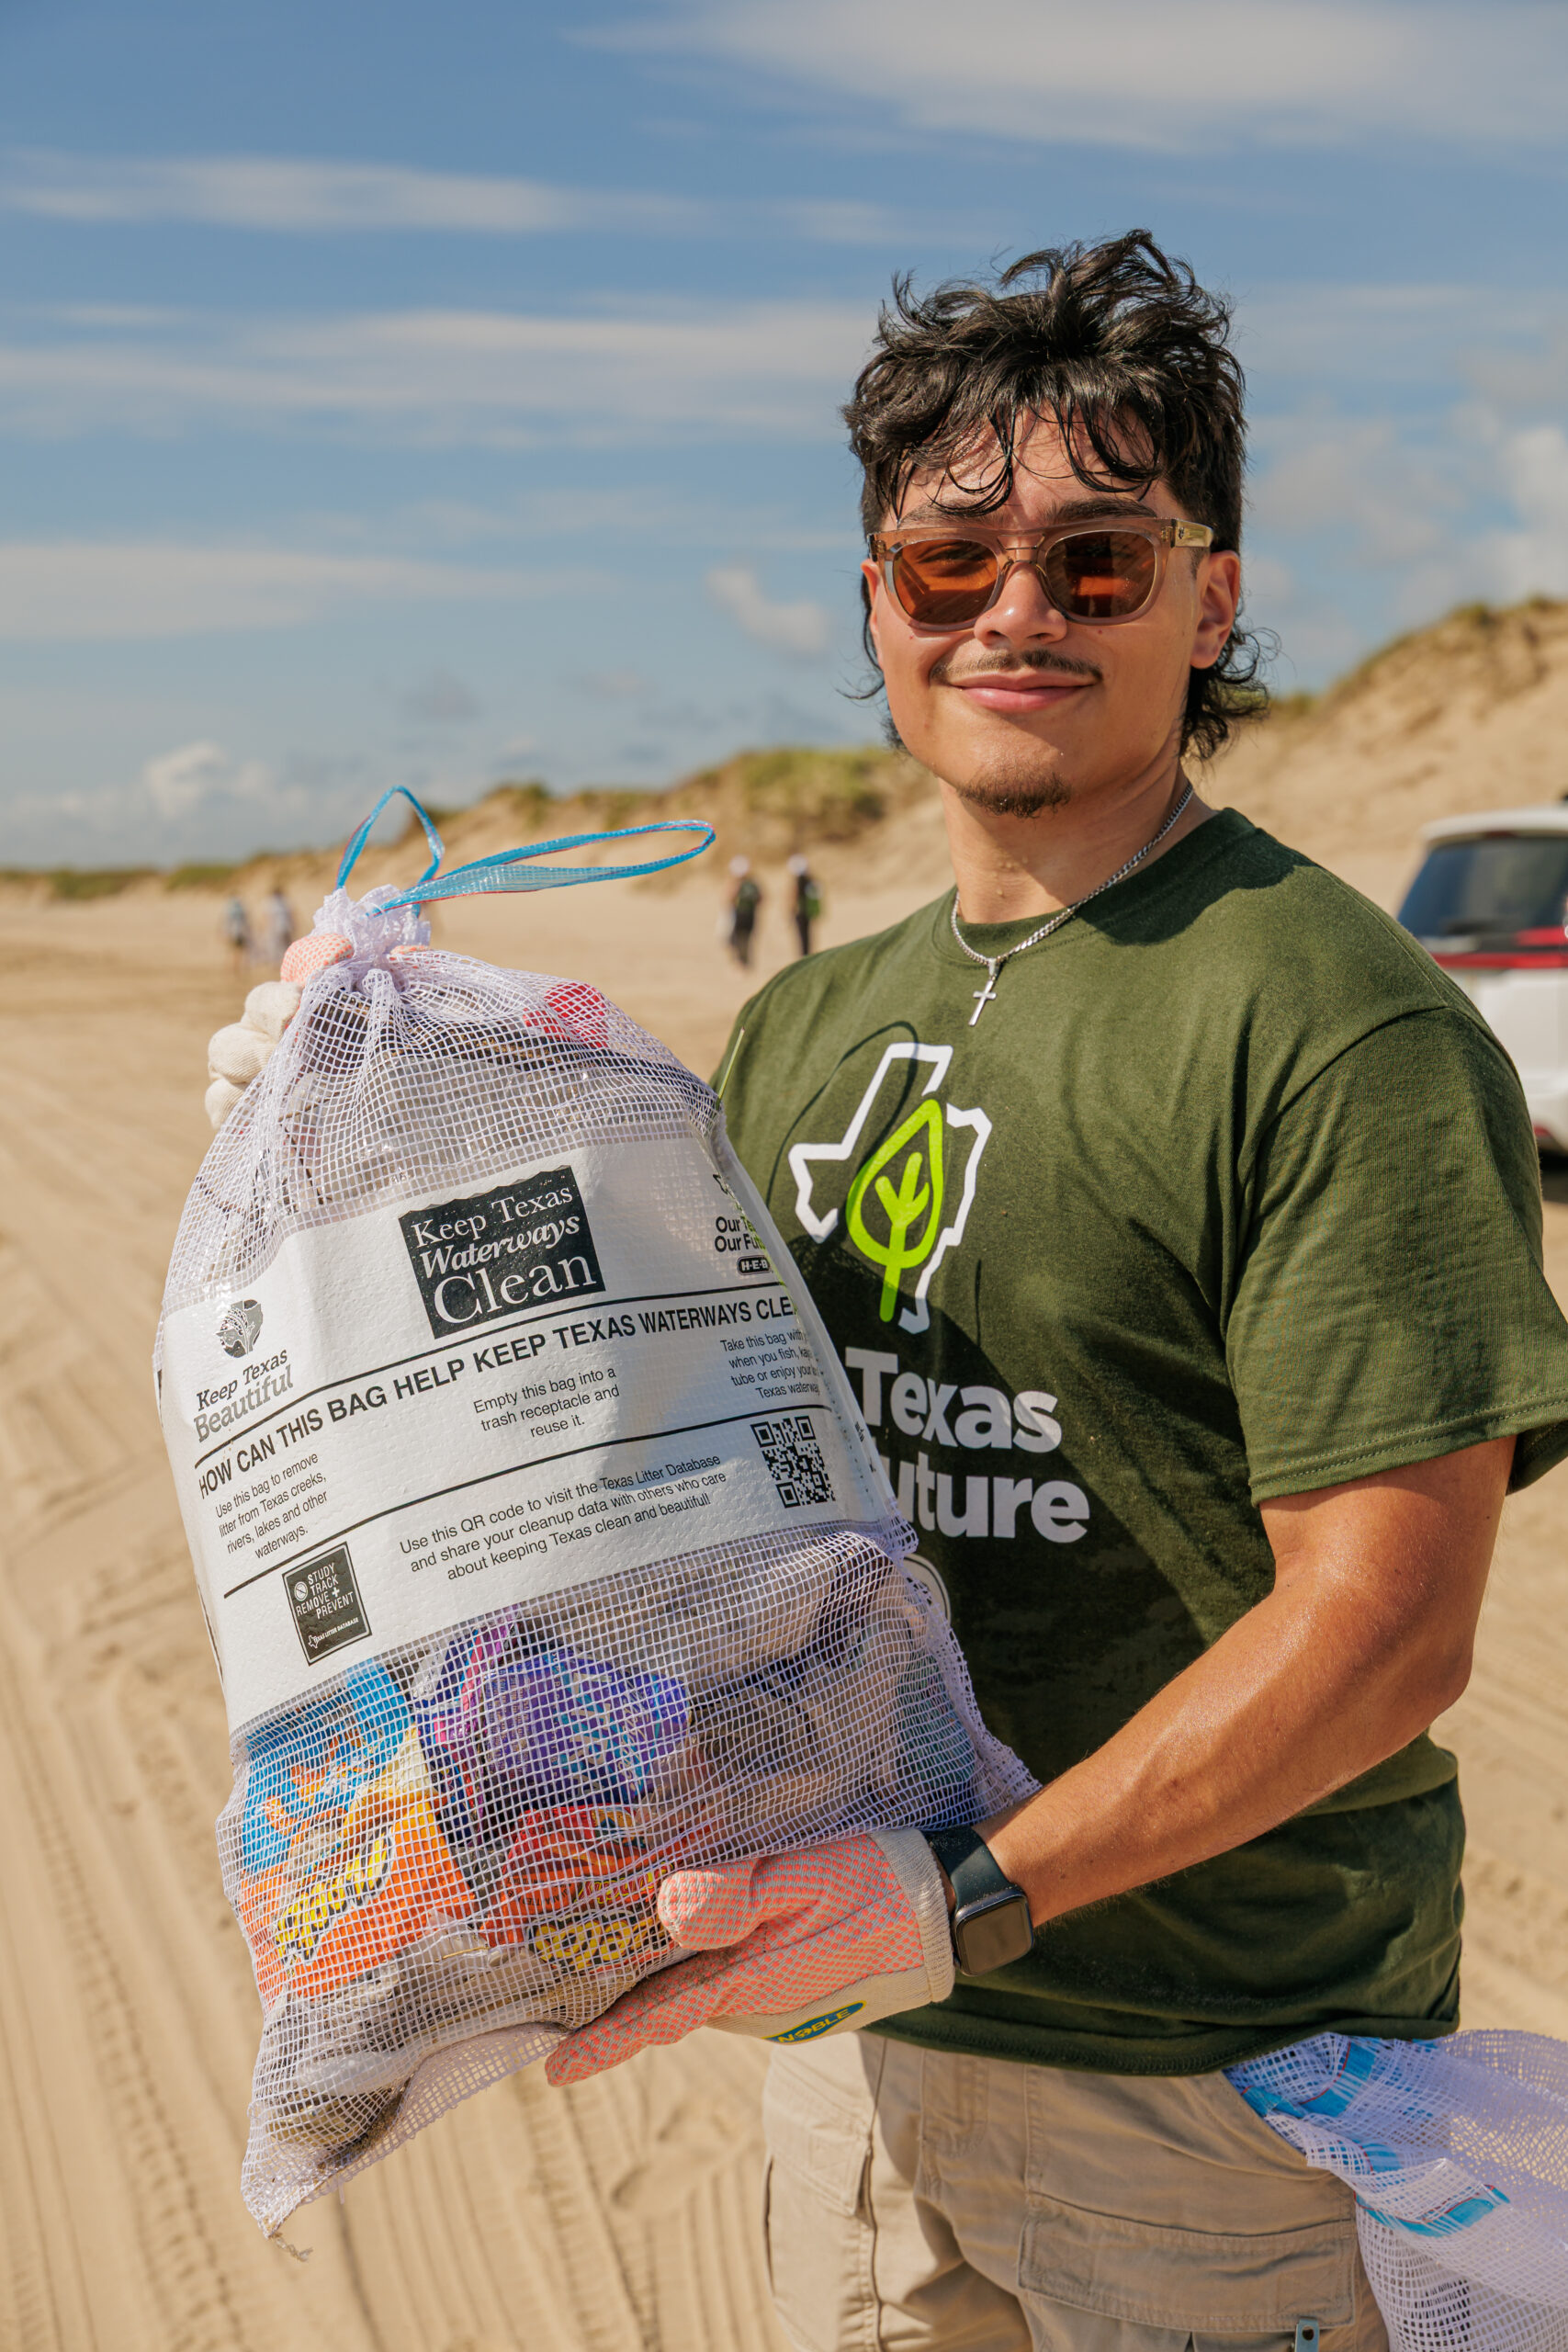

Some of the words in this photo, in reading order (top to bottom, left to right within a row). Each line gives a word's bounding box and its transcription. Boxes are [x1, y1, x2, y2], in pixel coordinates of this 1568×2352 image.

[412, 1215, 486, 1248] Keep
[491, 1187, 573, 1224] Texas
[716, 1216, 740, 1233] Our
[420, 1216, 580, 1278] Waterways
[715, 1236, 741, 1252] Our
[434, 1256, 596, 1323] Clean
[720, 1339, 745, 1351] Take
[746, 1335, 765, 1347] this
[765, 1334, 787, 1345] bag
[787, 1329, 803, 1340] with
[729, 1356, 757, 1368] when
[758, 1352, 777, 1366] you
[778, 1347, 800, 1360] fish,
[197, 1380, 238, 1411] Keep
[243, 1350, 288, 1385] Texas
[199, 1459, 231, 1499] HOW
[237, 1435, 276, 1472] CAN
[276, 1409, 323, 1448] THIS
[327, 1386, 388, 1423] BAG
[393, 1358, 464, 1399] HELP
[473, 1334, 546, 1372] KEEP
[553, 1315, 636, 1349] TEXAS
[637, 1301, 751, 1333] WATERWAYS
[756, 1296, 796, 1318] CLE
[474, 1391, 517, 1413] Empty
[522, 1384, 547, 1399] this
[549, 1377, 576, 1392] bag
[579, 1370, 604, 1385] into
[607, 1368, 616, 1378] a
[731, 1374, 755, 1386] tube
[757, 1372, 767, 1381] or
[770, 1366, 795, 1380] enjoy
[796, 1365, 811, 1378] your
[755, 1386, 787, 1398] Texas
[788, 1382, 820, 1396] waterway
[194, 1365, 293, 1442] Beautiful
[481, 1411, 517, 1430] trash
[521, 1393, 590, 1420] receptacle
[595, 1385, 620, 1401] and
[846, 1346, 1062, 1453] Texas
[530, 1420, 568, 1437] reuse
[572, 1414, 584, 1426] it.
[216, 1501, 232, 1518] Use
[233, 1491, 250, 1507] this
[252, 1481, 270, 1497] bag
[271, 1474, 281, 1486] to
[282, 1453, 318, 1480] remove
[219, 1520, 237, 1538] litter
[238, 1507, 259, 1526] from
[260, 1491, 289, 1512] Texas
[291, 1472, 327, 1497] creeks,
[400, 1537, 428, 1554] Use
[432, 1526, 458, 1543] this
[461, 1515, 486, 1532] QR
[489, 1504, 525, 1523] code
[527, 1499, 541, 1511] to
[545, 1487, 574, 1506] visit
[575, 1482, 598, 1497] the
[599, 1474, 634, 1490] Texas
[635, 1470, 664, 1484] Litter
[666, 1455, 721, 1476] Database
[878, 1451, 1090, 1543] uture
[227, 1533, 254, 1554] rivers,
[254, 1517, 281, 1538] lakes
[282, 1504, 301, 1523] and
[303, 1491, 327, 1512] other
[255, 1525, 308, 1559] waterways.
[411, 1552, 437, 1572] and
[440, 1540, 480, 1562] share
[483, 1528, 514, 1549] your
[519, 1511, 574, 1535] cleanup
[577, 1499, 608, 1517] data
[610, 1492, 636, 1508] with
[637, 1484, 673, 1501] others
[674, 1478, 699, 1493] who
[701, 1471, 727, 1487] care
[448, 1557, 489, 1580] about
[491, 1540, 547, 1565] keeping
[548, 1526, 592, 1546] Texas
[596, 1515, 632, 1533] clean
[635, 1505, 657, 1522] and
[658, 1493, 711, 1516] beautiful!
[308, 1562, 335, 1585] STUDY
[310, 1574, 338, 1596] TRACK
[296, 1591, 330, 1617] REMOVE
[316, 1592, 353, 1619] PREVENT
[337, 1617, 359, 1631] DATABASE
